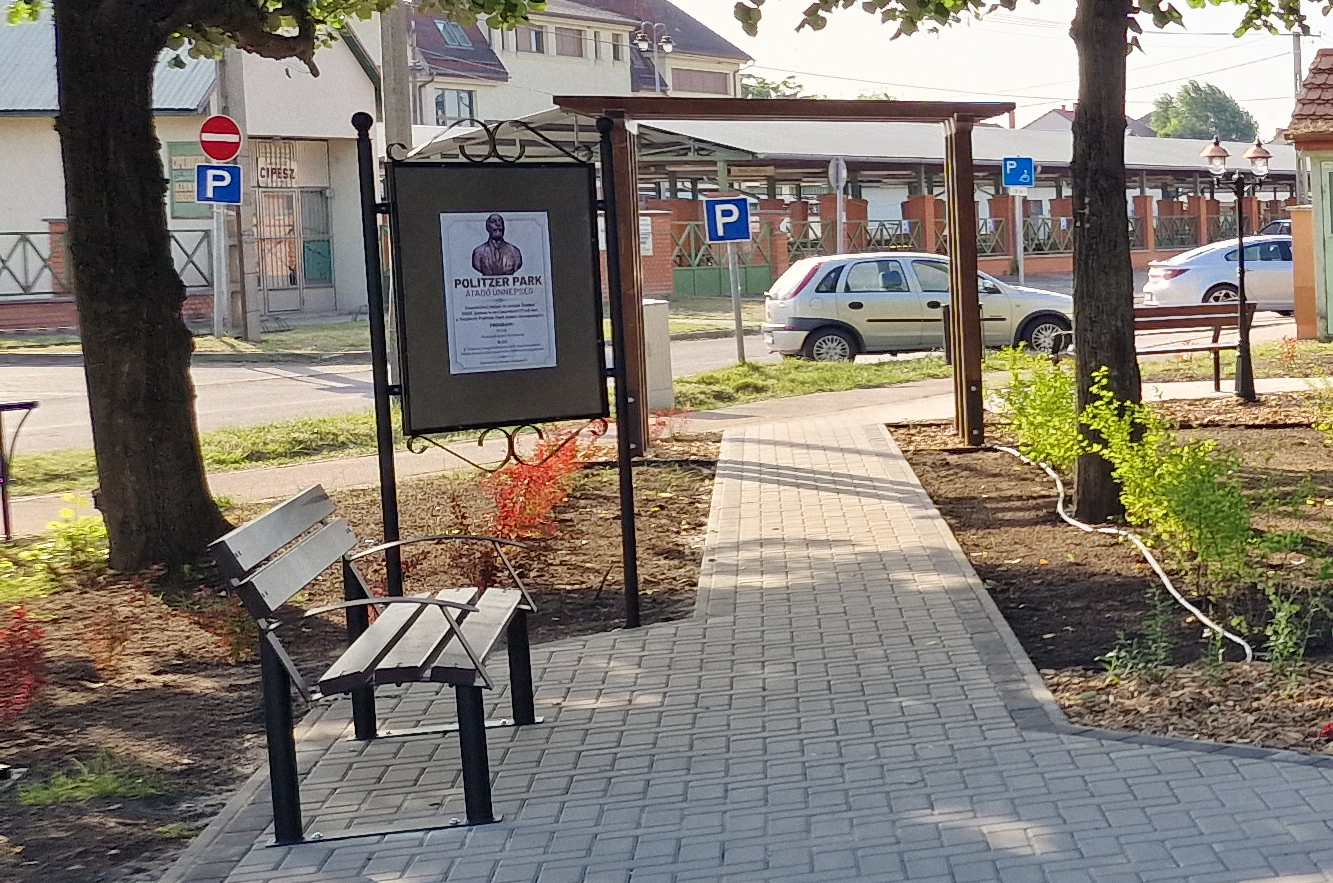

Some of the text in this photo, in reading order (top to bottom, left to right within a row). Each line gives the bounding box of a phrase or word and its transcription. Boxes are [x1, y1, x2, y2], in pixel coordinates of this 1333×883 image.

[1006, 160, 1017, 174] P
[205, 169, 232, 198] P
[714, 203, 740, 237] P
[454, 276, 543, 288] POLITZER PARK
[465, 289, 492, 298] ÁTADÓ
